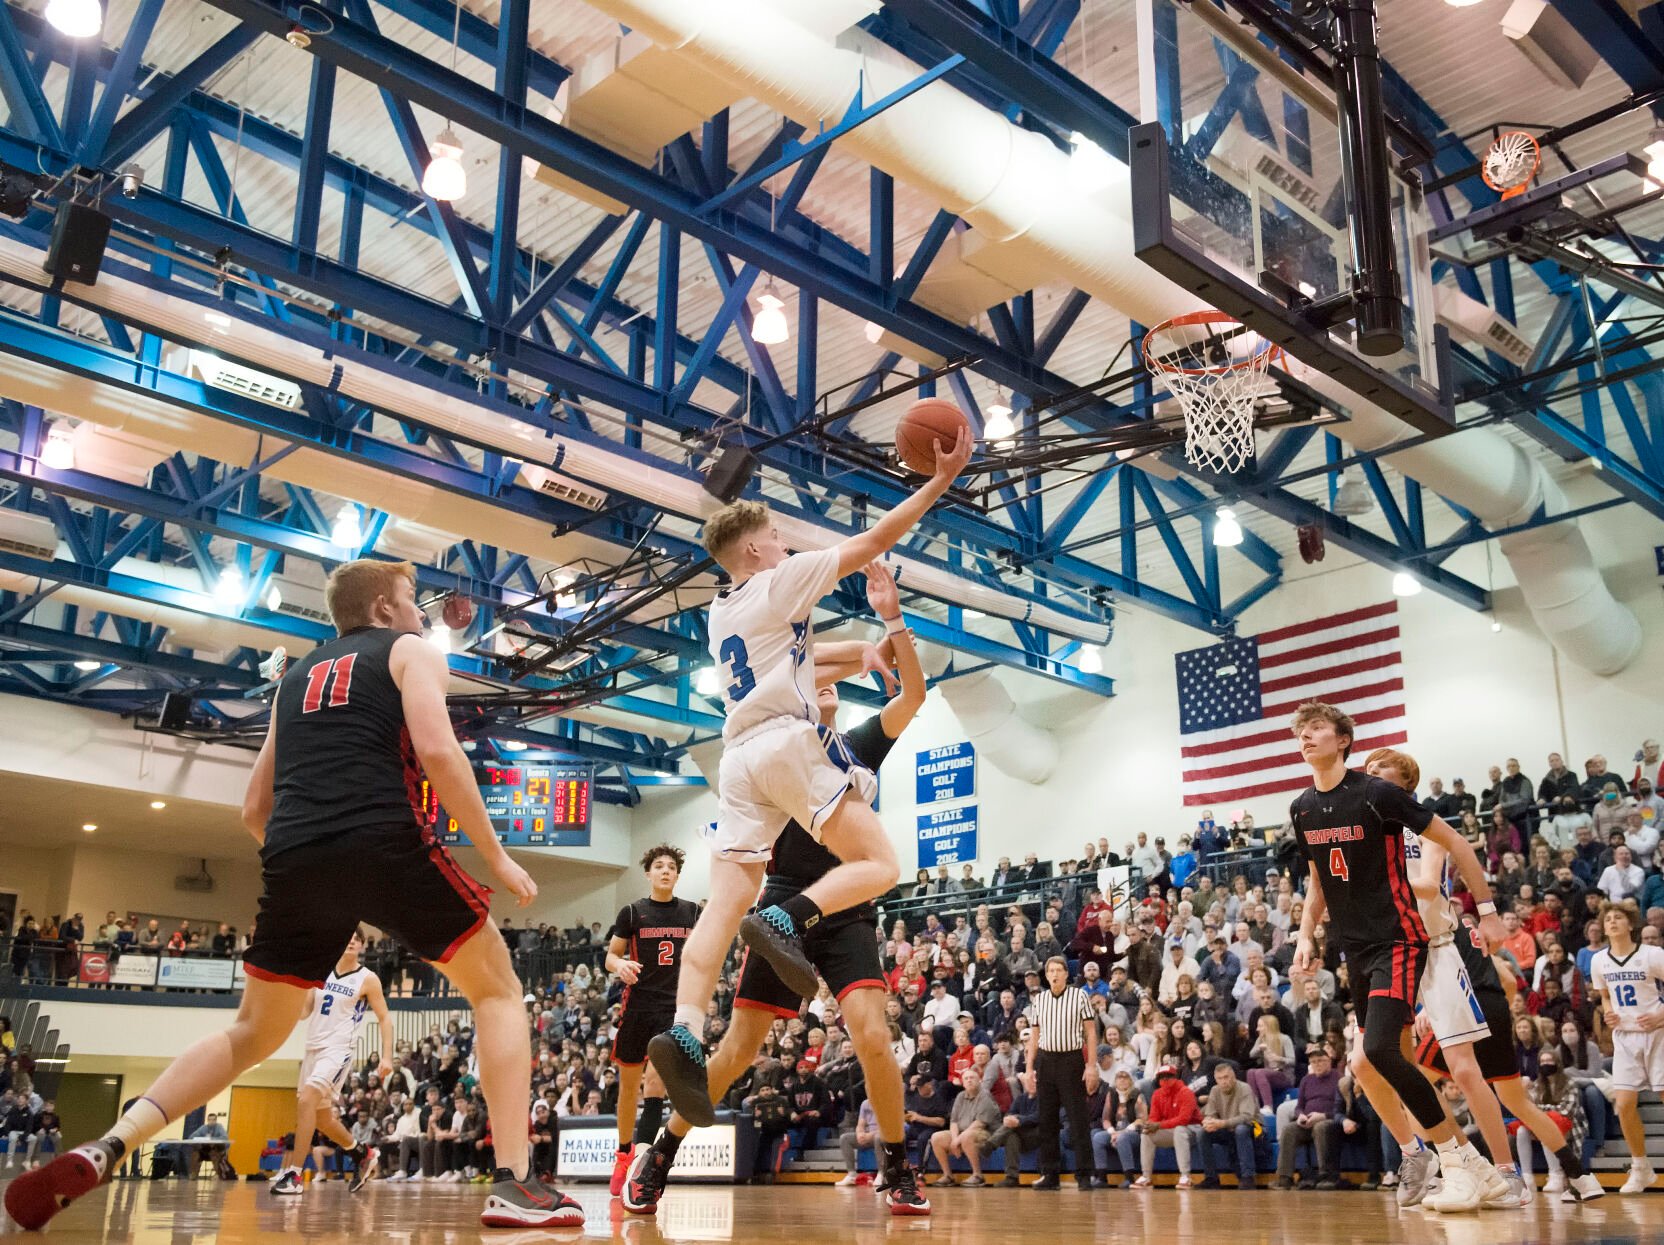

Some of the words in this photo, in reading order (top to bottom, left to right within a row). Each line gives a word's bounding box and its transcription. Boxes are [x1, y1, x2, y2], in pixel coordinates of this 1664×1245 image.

[720, 634, 756, 702] 3
[302, 652, 358, 714] 11
[929, 744, 961, 760] STATE
[917, 756, 973, 776] CHAMPIONS
[527, 777, 550, 796] 27
[932, 773, 957, 787] GOLF
[486, 795, 507, 804] period
[513, 791, 522, 804] 3
[935, 788, 954, 800] 2011
[931, 809, 963, 824] STATE
[534, 818, 544, 832] 0
[919, 820, 976, 840] CHAMPIONS
[934, 838, 960, 852] GOLF
[936, 852, 958, 866] 2012
[1329, 848, 1349, 882] 4
[658, 940, 674, 966] 2
[1603, 971, 1647, 982] PIONEERS
[325, 982, 355, 997] NEERS
[1614, 984, 1638, 1007] 12
[320, 994, 334, 1016] 2
[565, 1139, 616, 1150] MANHEI
[562, 1152, 616, 1163] TOWNSH
[690, 1144, 730, 1167] STREAKS
